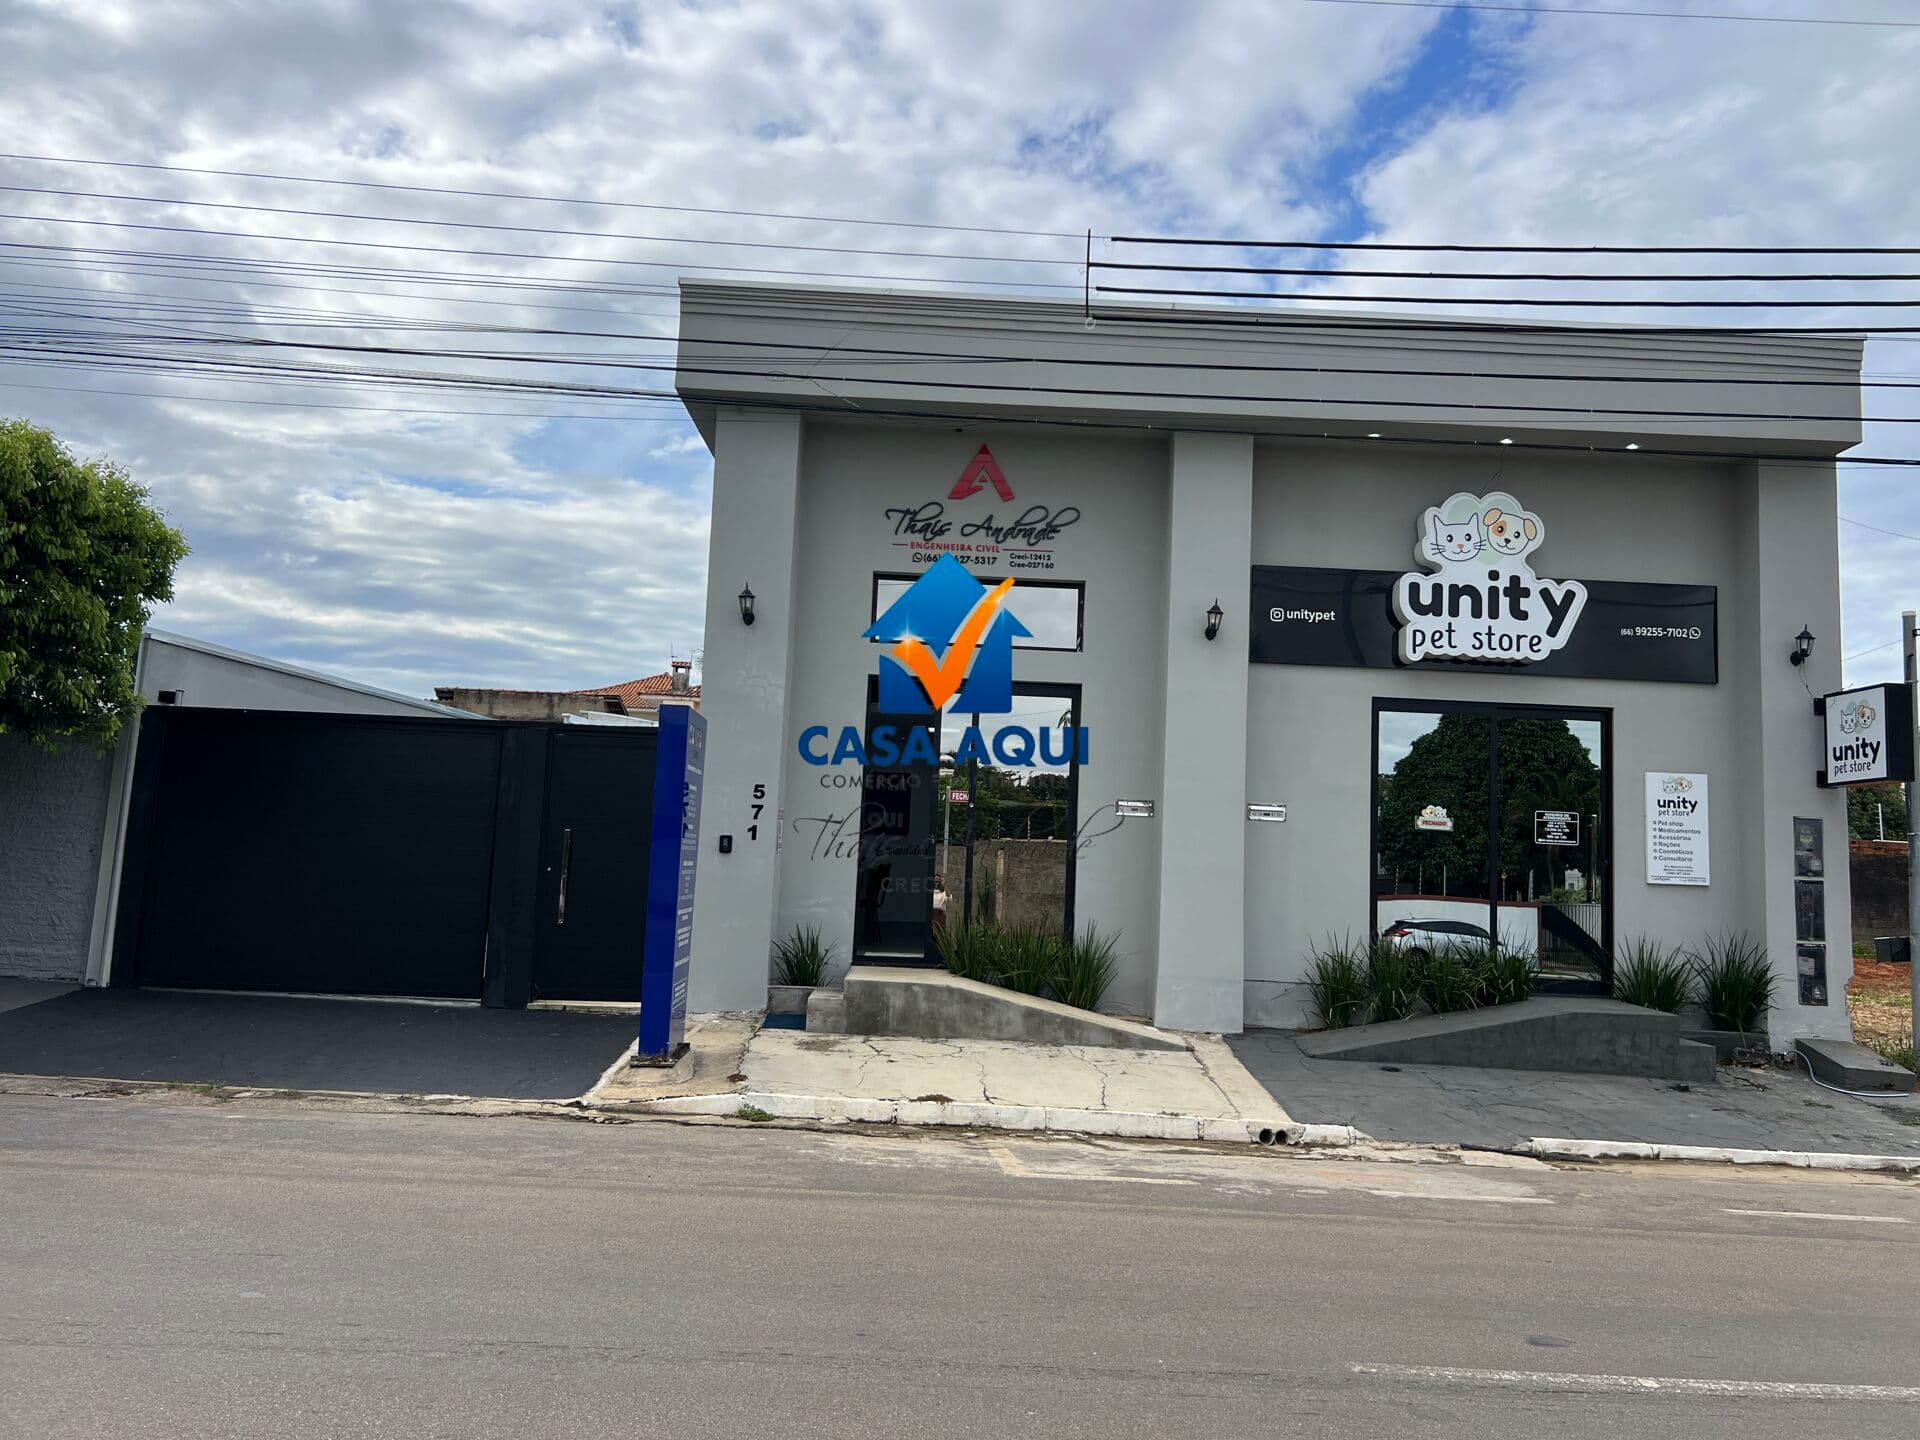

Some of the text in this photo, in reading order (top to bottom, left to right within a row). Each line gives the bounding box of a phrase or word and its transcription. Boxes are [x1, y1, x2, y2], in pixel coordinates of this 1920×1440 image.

[961, 506, 1081, 546] Andrade
[911, 542, 1000, 553] ENGENHEIRA CIVIL
[945, 554, 998, 565] 627-5317
[1408, 570, 1576, 638] unity
[1286, 604, 1336, 623] unitypet
[1412, 622, 1542, 654] pet store
[1620, 626, 1688, 638] (66) 99255-7102
[1832, 737, 1881, 764] unity
[1834, 761, 1872, 776] pet store
[1657, 796, 1698, 813] unity
[1658, 809, 1690, 817] pet store
